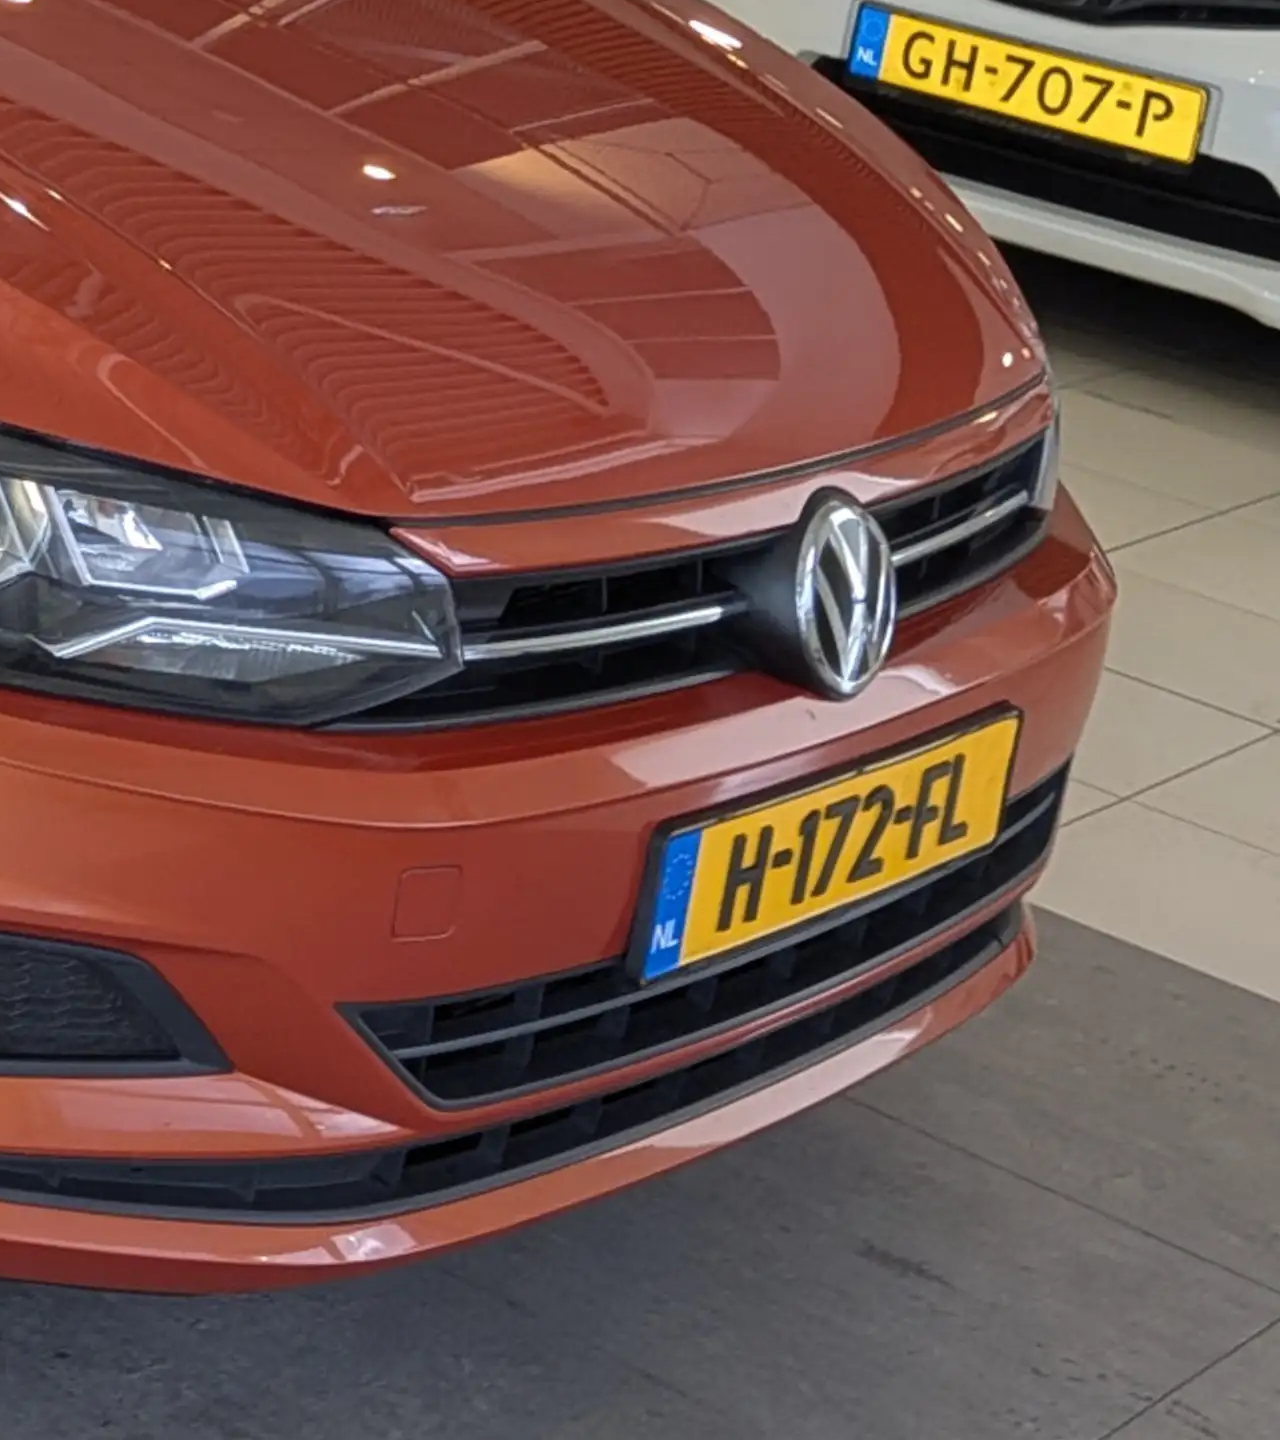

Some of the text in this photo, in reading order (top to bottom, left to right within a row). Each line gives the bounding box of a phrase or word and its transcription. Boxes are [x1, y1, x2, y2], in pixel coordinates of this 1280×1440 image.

[857, 46, 878, 67] NL
[902, 30, 1175, 138] GH-707-P
[715, 753, 970, 933] H-172-FL
[649, 917, 681, 955] NL
